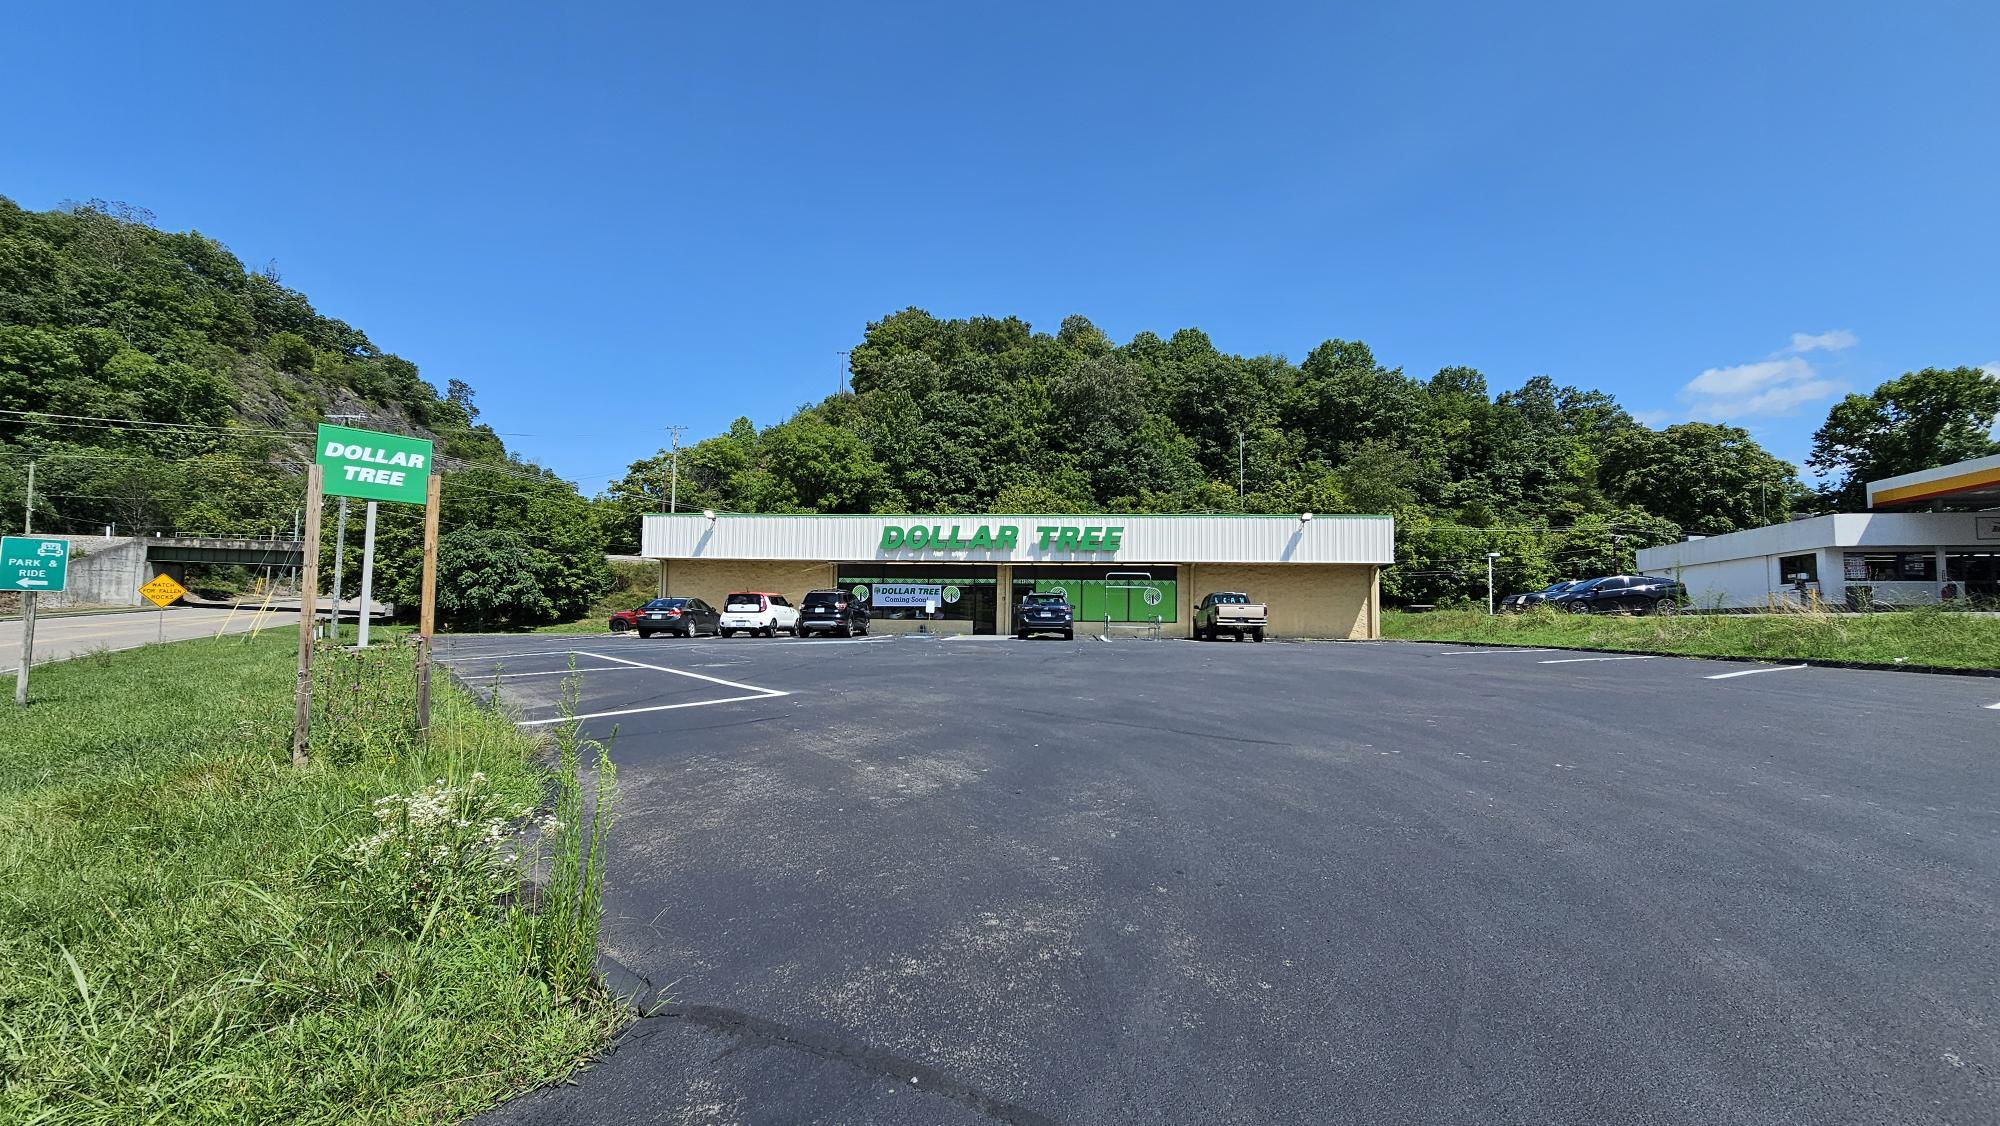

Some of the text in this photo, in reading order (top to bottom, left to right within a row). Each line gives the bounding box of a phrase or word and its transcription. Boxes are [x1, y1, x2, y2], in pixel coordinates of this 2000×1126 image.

[324, 441, 425, 468] DOLLAR
[343, 465, 406, 486] TREE
[880, 525, 1124, 551] DOLLAR TREE
[8, 558, 58, 568] PARK &
[18, 569, 47, 578] RIDE
[881, 587, 940, 596] DOLLAR TREE
[884, 596, 910, 604] Coming
